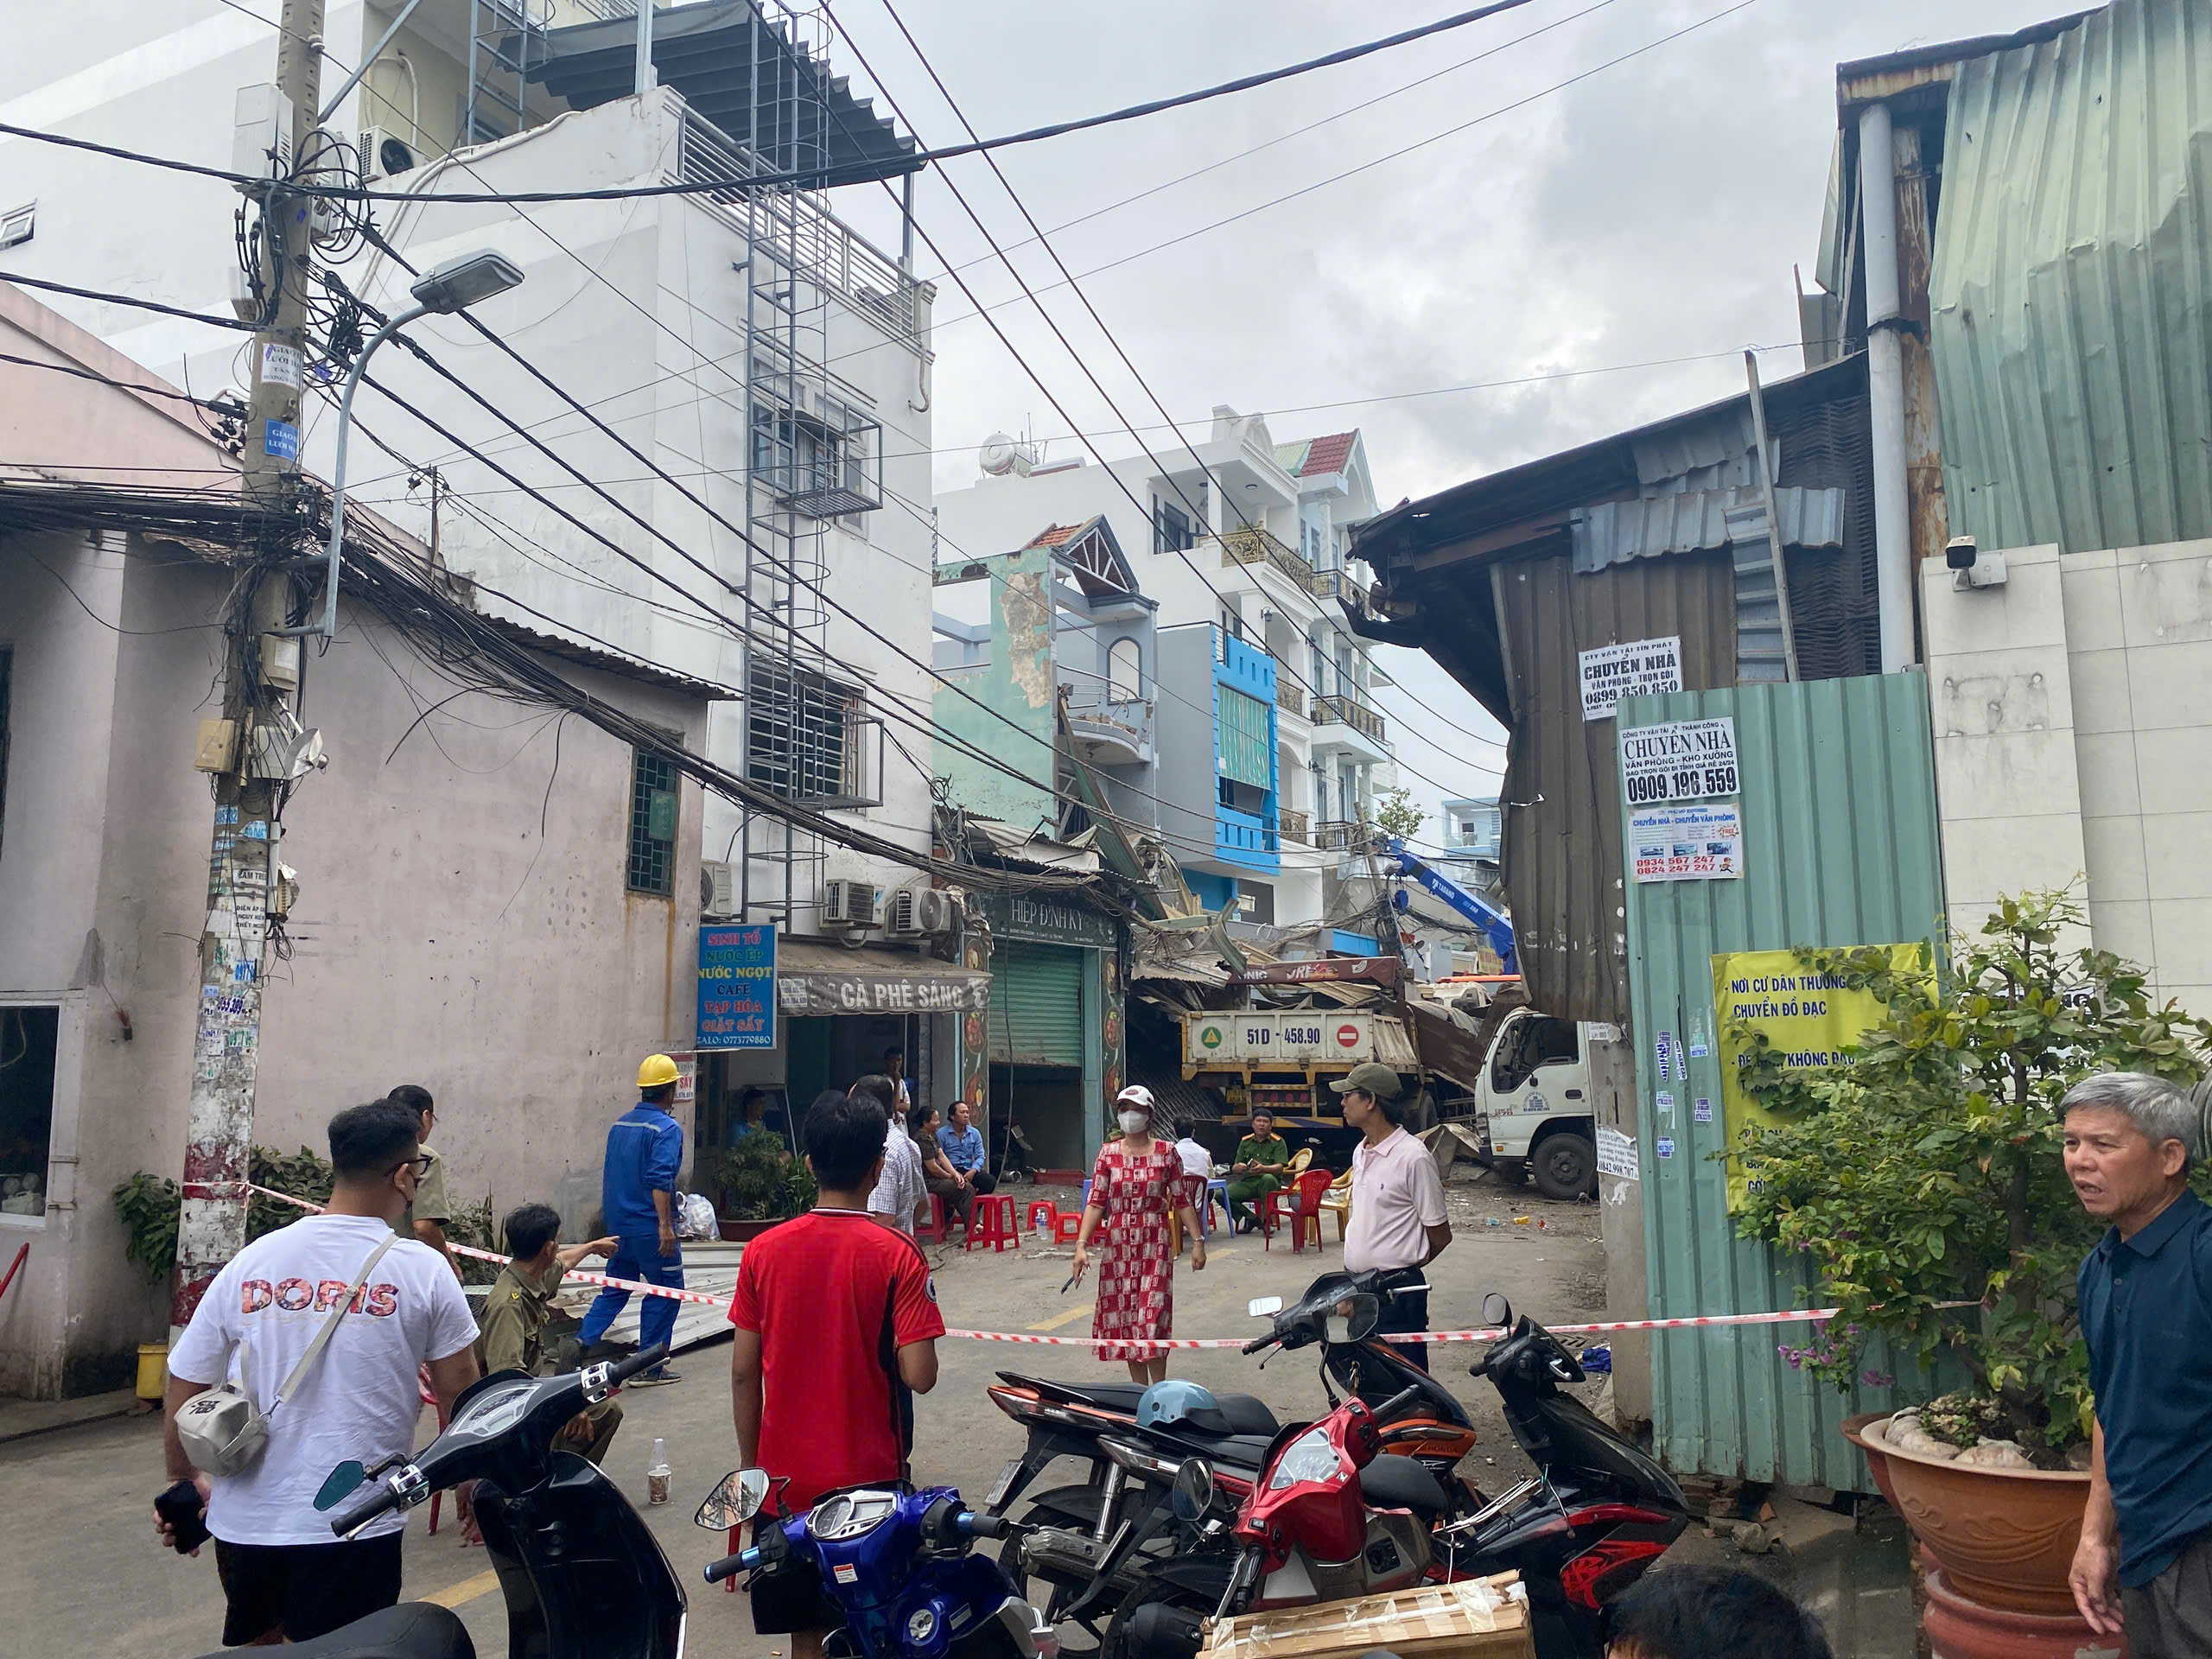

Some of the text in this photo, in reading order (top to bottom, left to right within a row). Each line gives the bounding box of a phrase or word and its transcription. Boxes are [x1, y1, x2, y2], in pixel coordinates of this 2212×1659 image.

[1584, 649, 1676, 681] CHUYỂN NHÀ
[1638, 672, 1658, 683] TRỌN
[1585, 688, 1618, 705] 0899
[1624, 723, 1732, 760] CHUYỂN NHÀ
[1644, 756, 1675, 767] PHÒNG
[1702, 749, 1733, 760] XƯỞNG
[1627, 766, 1737, 803] 0909.196.559
[1637, 858, 1665, 868] 0934
[1669, 864, 1689, 873] 247
[1694, 863, 1715, 872] 247
[708, 927, 761, 946] SINH TỐ
[698, 965, 772, 982] NƯỚC NGỌT
[1731, 976, 1749, 994] NƠI
[1752, 976, 1769, 993] CƯ
[1772, 974, 1796, 992] DÂN
[840, 977, 871, 1010] CÀ
[874, 978, 914, 1010] PHÊ
[918, 979, 965, 1008] SÁNG
[704, 1001, 730, 1015] TẠP
[1734, 995, 1827, 1019] CHUYỂN ĐỒ ĐẠC
[723, 1036, 771, 1045] 0773779880
[1284, 1027, 1321, 1045] 458.90
[1787, 1048, 1828, 1067] KHÔNG
[241, 1277, 400, 1318] DORIS
